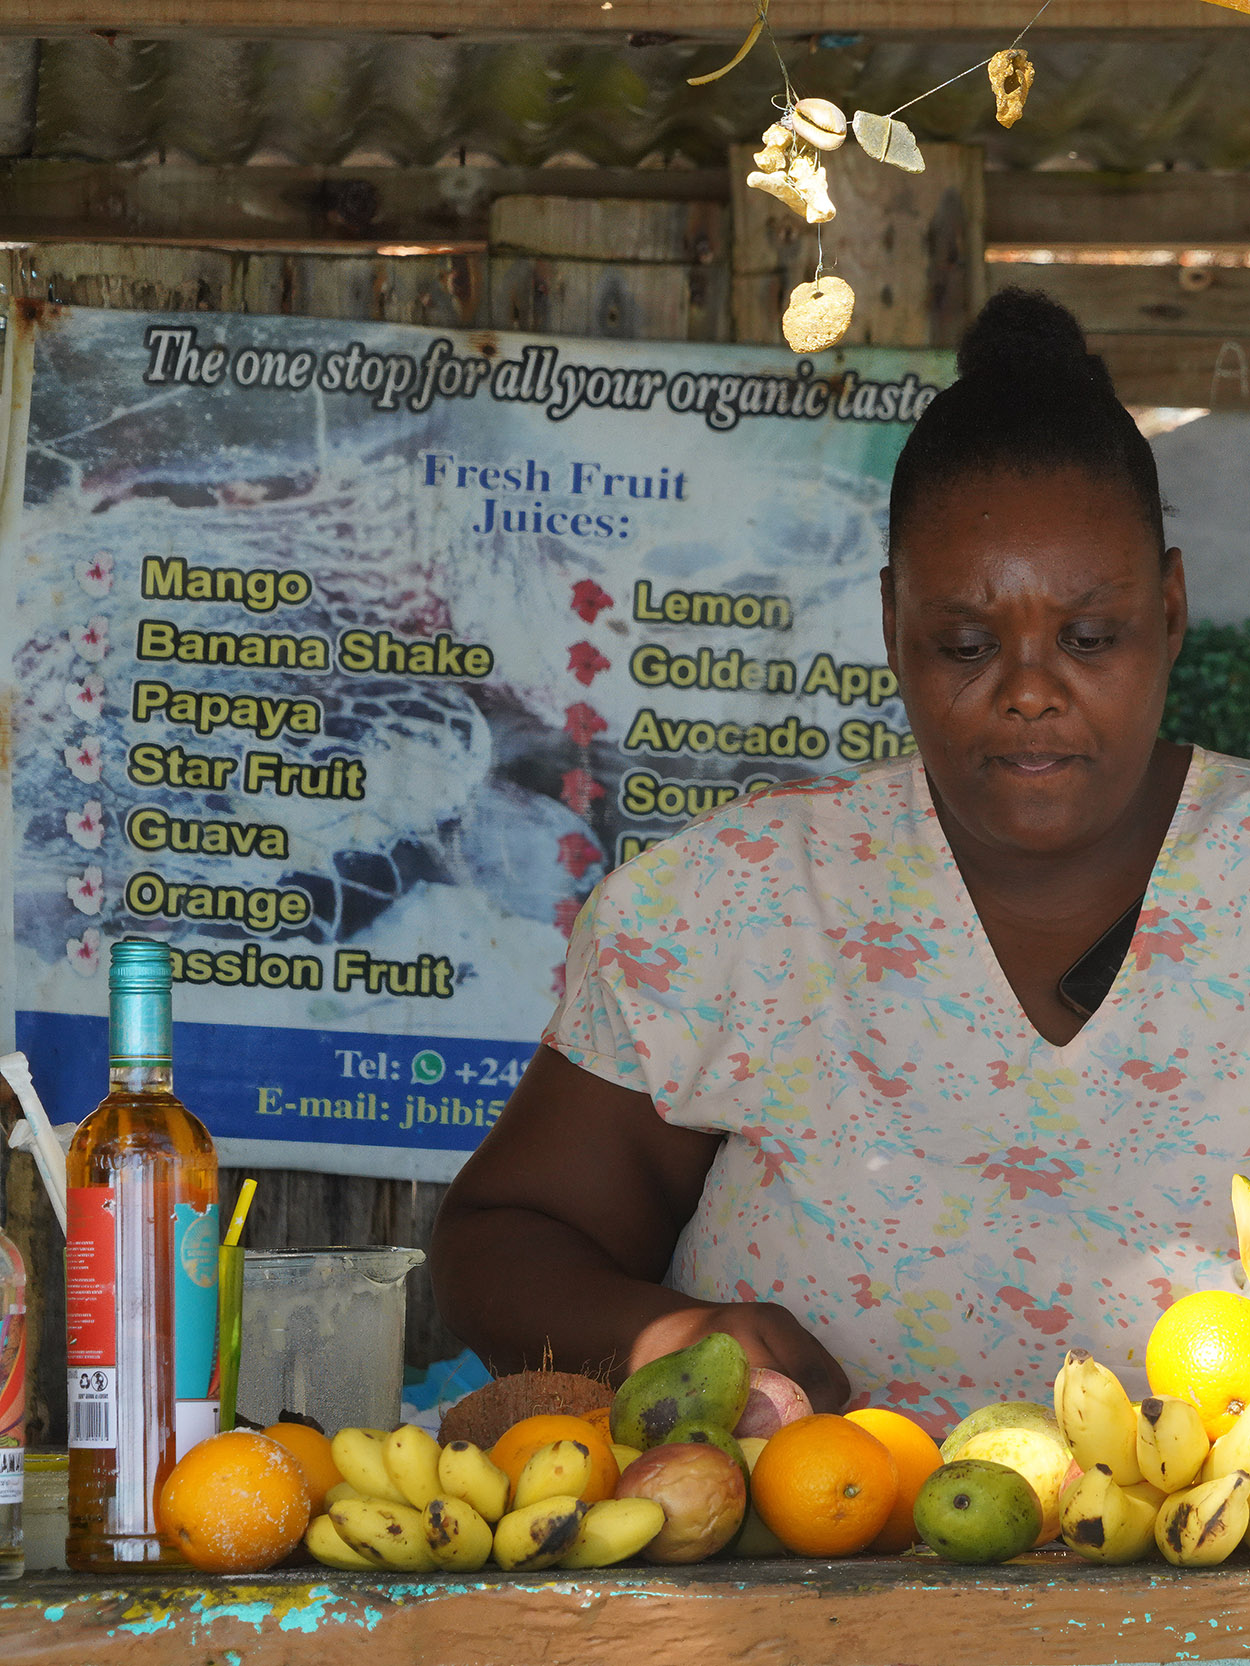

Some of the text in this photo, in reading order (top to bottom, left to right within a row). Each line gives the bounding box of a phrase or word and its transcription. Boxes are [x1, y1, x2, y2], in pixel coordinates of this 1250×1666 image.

[146, 327, 227, 386] The
[234, 348, 314, 389] one
[319, 344, 413, 409] stop
[411, 339, 489, 411] for
[495, 346, 556, 400] all
[548, 368, 664, 420] your
[666, 361, 829, 430] organic
[422, 453, 690, 502] Fresh Fruit
[472, 498, 630, 539] Juices:
[143, 557, 311, 612] Mango
[634, 581, 793, 630] Lemon
[138, 620, 493, 676] Banana Shake
[630, 644, 797, 693] Golden
[134, 681, 320, 739] Papaya
[625, 708, 829, 758] Avocado
[129, 743, 366, 799] Star Fruit
[625, 772, 738, 817] Sour
[127, 808, 290, 860] Guava
[126, 872, 311, 931] Orange
[170, 944, 454, 998] assion Fruit
[335, 1049, 401, 1081] Tel:
[255, 1086, 390, 1122] E-mail:
